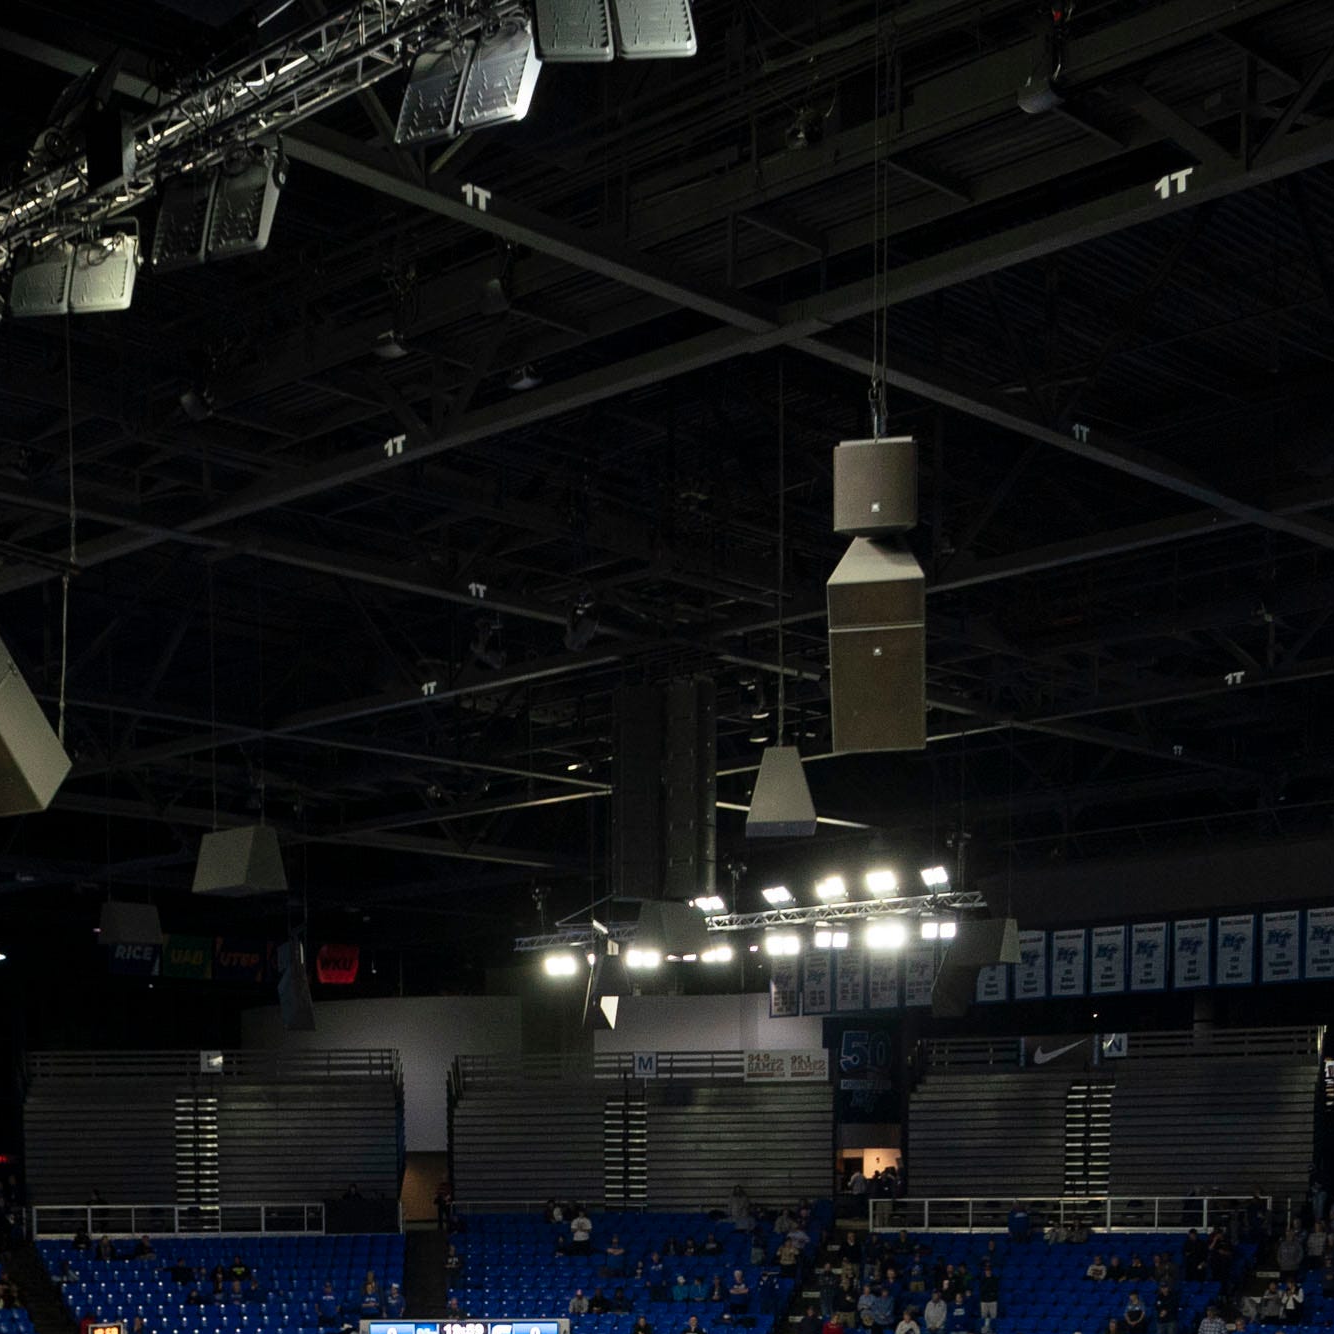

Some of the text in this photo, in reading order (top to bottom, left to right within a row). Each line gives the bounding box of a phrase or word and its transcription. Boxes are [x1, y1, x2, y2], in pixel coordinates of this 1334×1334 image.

[116, 945, 154, 960] RICE
[840, 1030, 892, 1073] 50
[637, 1055, 653, 1071] M
